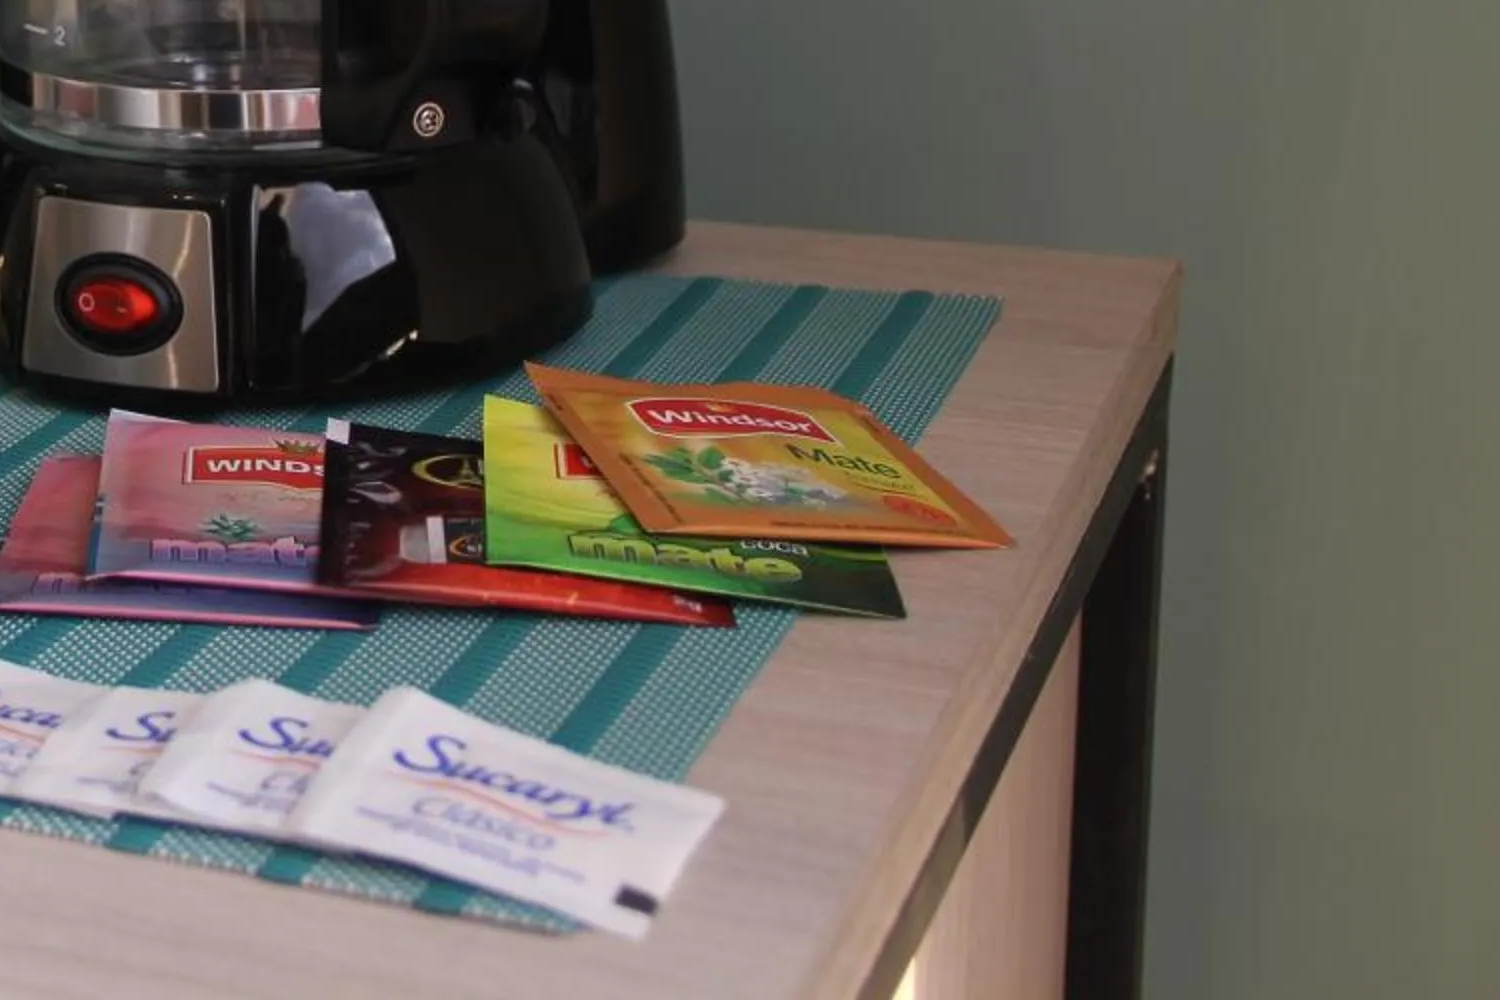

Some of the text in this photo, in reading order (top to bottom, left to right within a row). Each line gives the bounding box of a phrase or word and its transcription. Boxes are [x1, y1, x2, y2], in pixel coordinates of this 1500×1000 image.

[53, 25, 66, 47] 2
[647, 408, 813, 434] Windsor
[785, 442, 901, 479] Mate
[567, 532, 803, 582] mate
